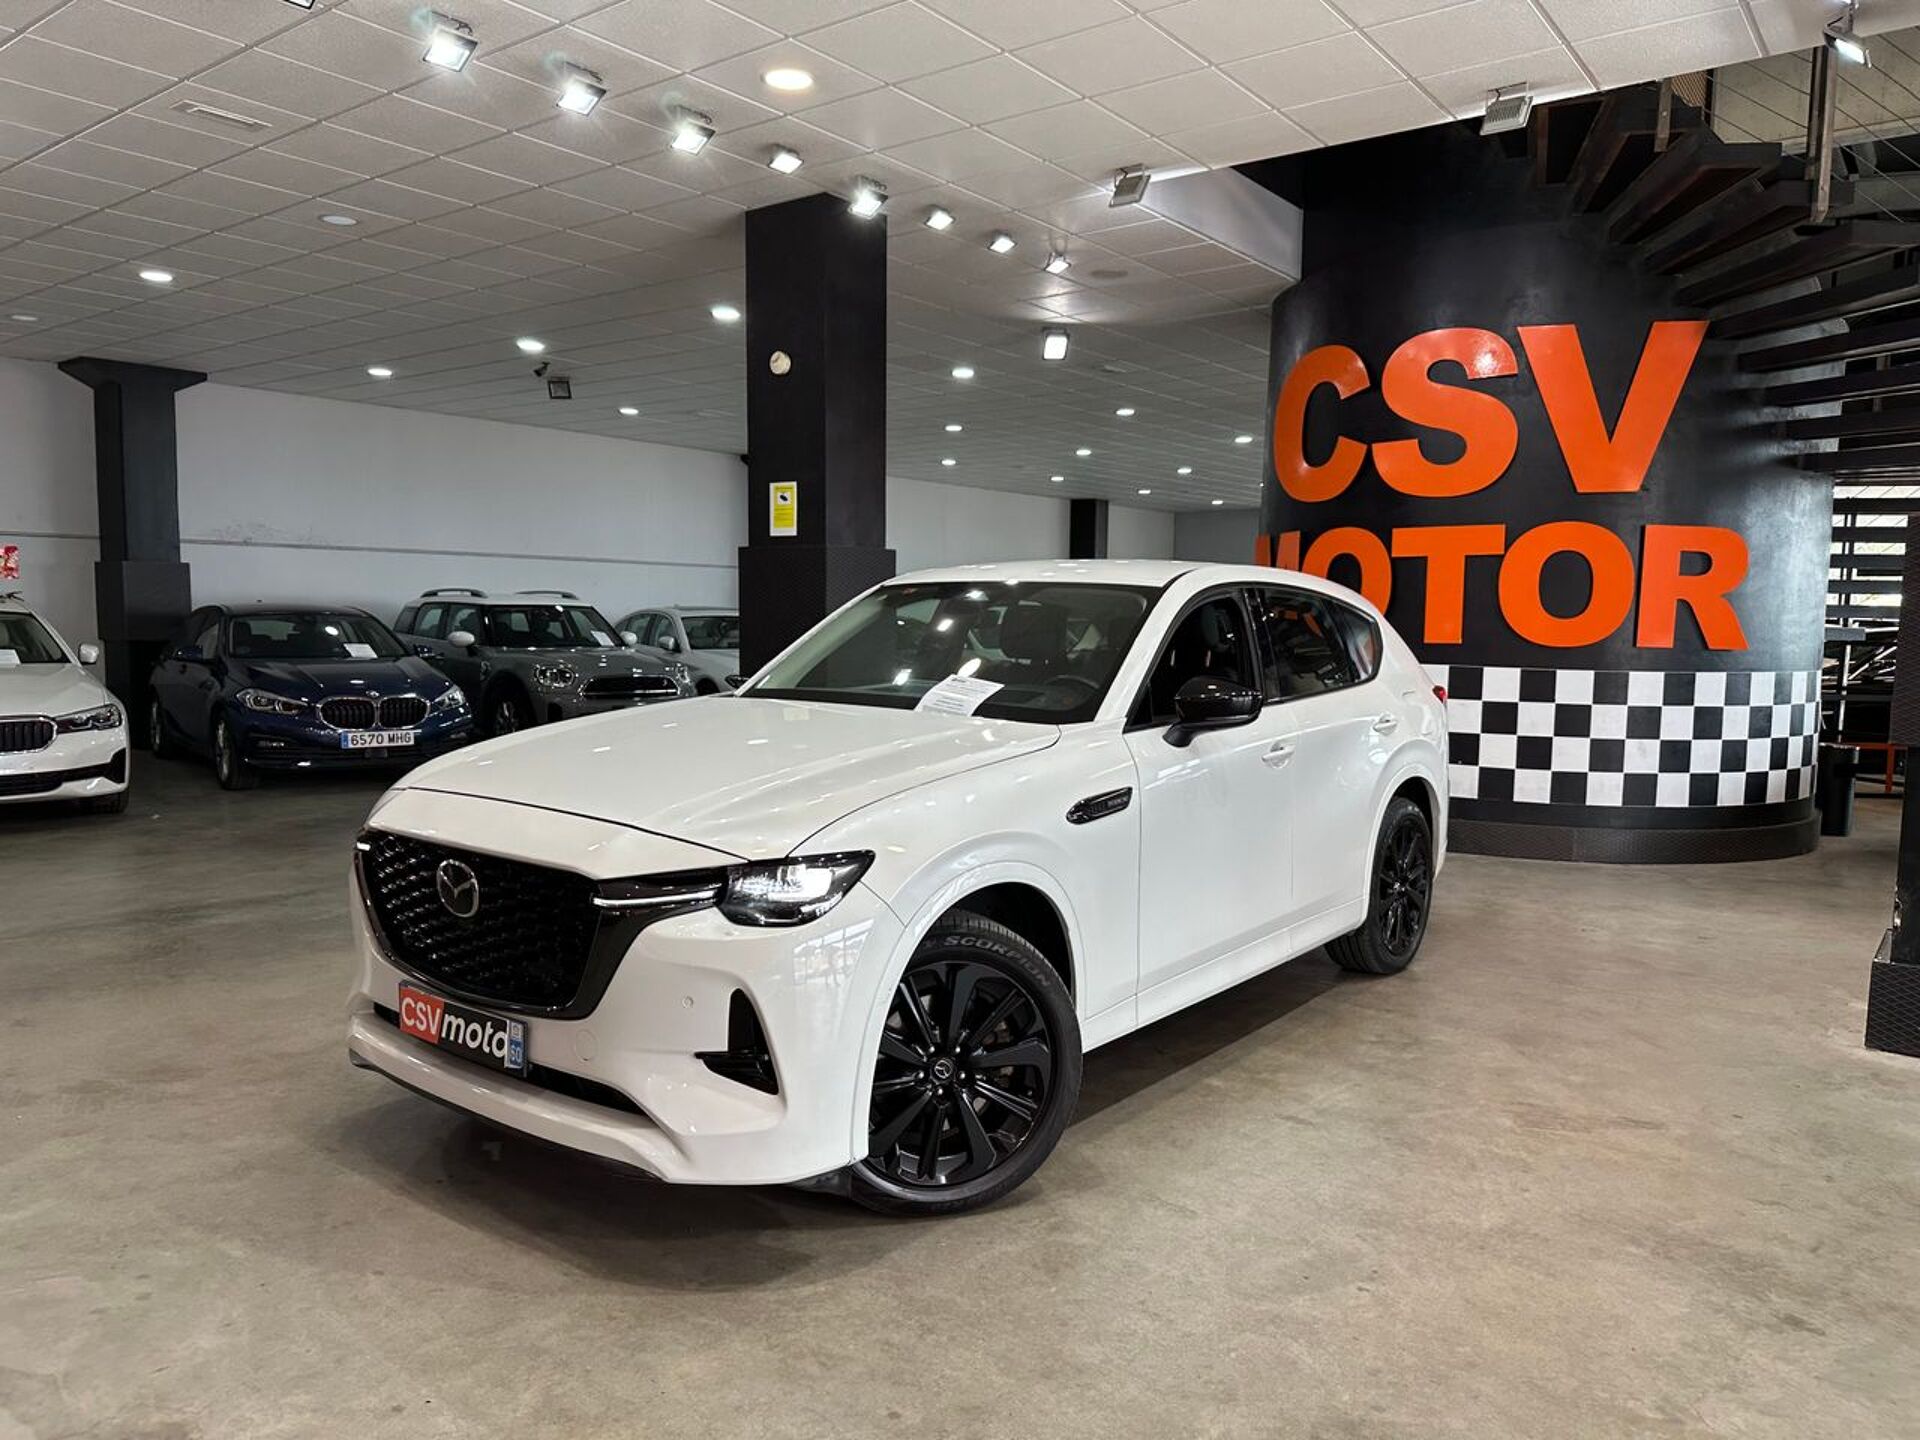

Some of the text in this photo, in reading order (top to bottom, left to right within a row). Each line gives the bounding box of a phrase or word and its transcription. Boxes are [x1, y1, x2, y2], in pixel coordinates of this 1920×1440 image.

[1274, 321, 1707, 503] CSV
[350, 731, 412, 746] 6570 MHG
